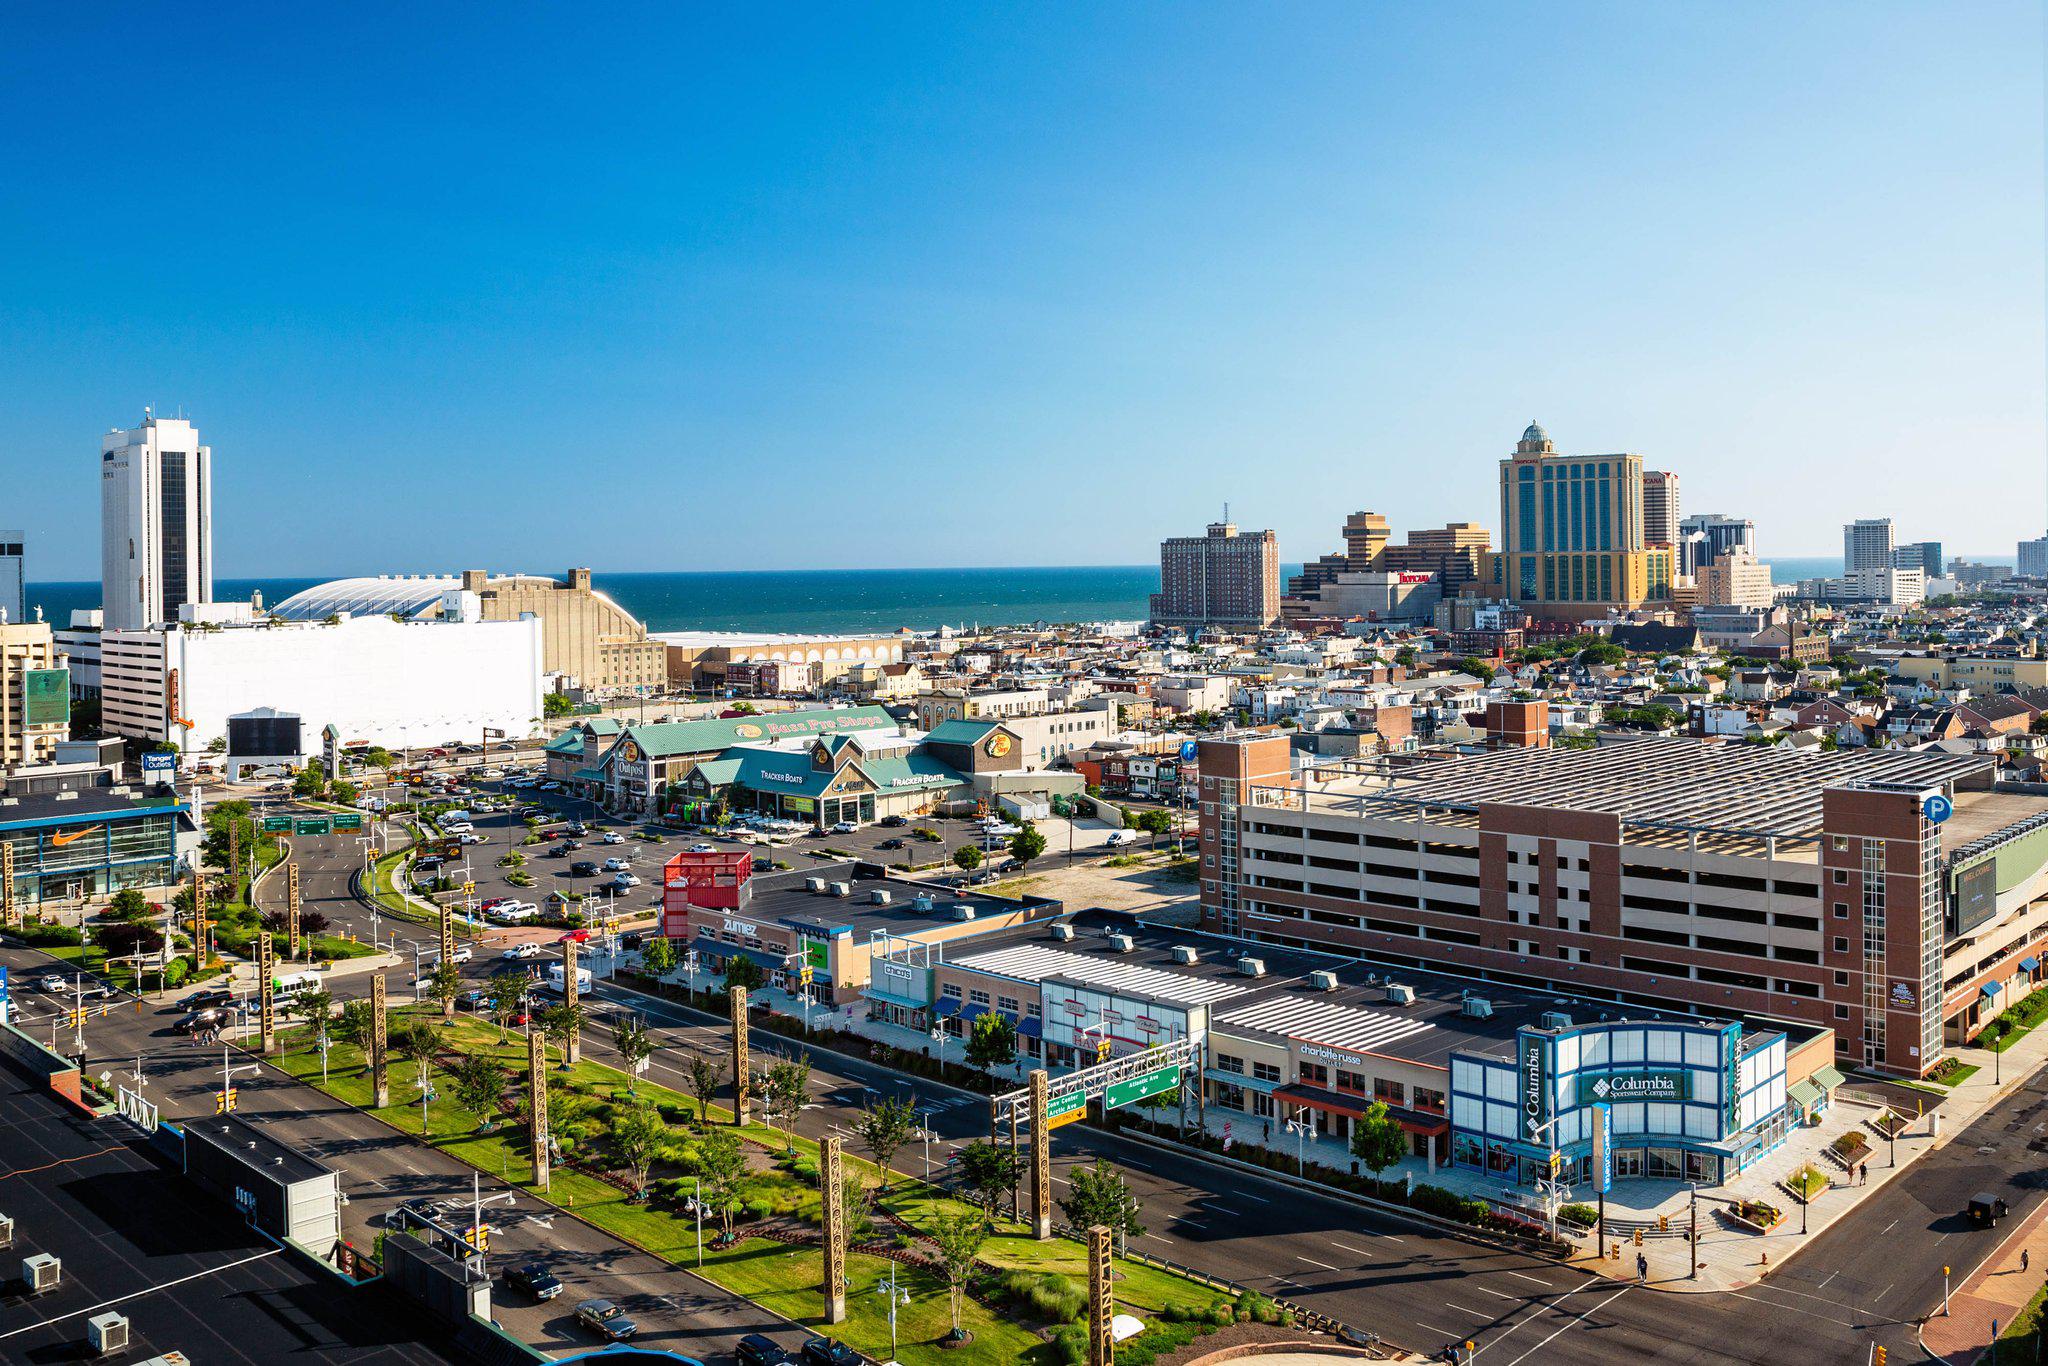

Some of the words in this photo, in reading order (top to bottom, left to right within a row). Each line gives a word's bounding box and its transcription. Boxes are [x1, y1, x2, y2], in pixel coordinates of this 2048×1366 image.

[1398, 572, 1431, 584] TROPICANA
[766, 723, 808, 734] Bass
[806, 719, 836, 731] Pro
[837, 716, 884, 728] Shops
[619, 761, 644, 776] Outpost
[761, 770, 785, 782] TRACKER
[785, 773, 803, 784] BOATS
[892, 776, 922, 787] TRACKER
[922, 773, 944, 783] BOATS
[1931, 800, 1945, 818] P
[289, 864, 298, 916] ATLANTIC
[196, 875, 205, 927] ATLANTIC
[291, 923, 299, 948] CITY
[197, 936, 206, 962] CITY
[262, 933, 272, 999] ATLANTIC
[885, 965, 910, 978] chico's
[265, 1006, 274, 1037] CITY
[1300, 1043, 1338, 1060] charlotte
[1338, 1054, 1362, 1065] russe
[1320, 1058, 1343, 1068] OUTLET
[1128, 1078, 1149, 1089] Atlantic
[1149, 1074, 1159, 1082] Ave
[1526, 1047, 1539, 1116] Columbia
[1611, 1076, 1674, 1091] Columbia
[1061, 1094, 1079, 1104] Center
[1610, 1089, 1645, 1099] Sportswear
[1645, 1088, 1676, 1098] Company
[1049, 1107, 1066, 1117] Arctic
[1101, 1234, 1111, 1347] ATLANTIC
